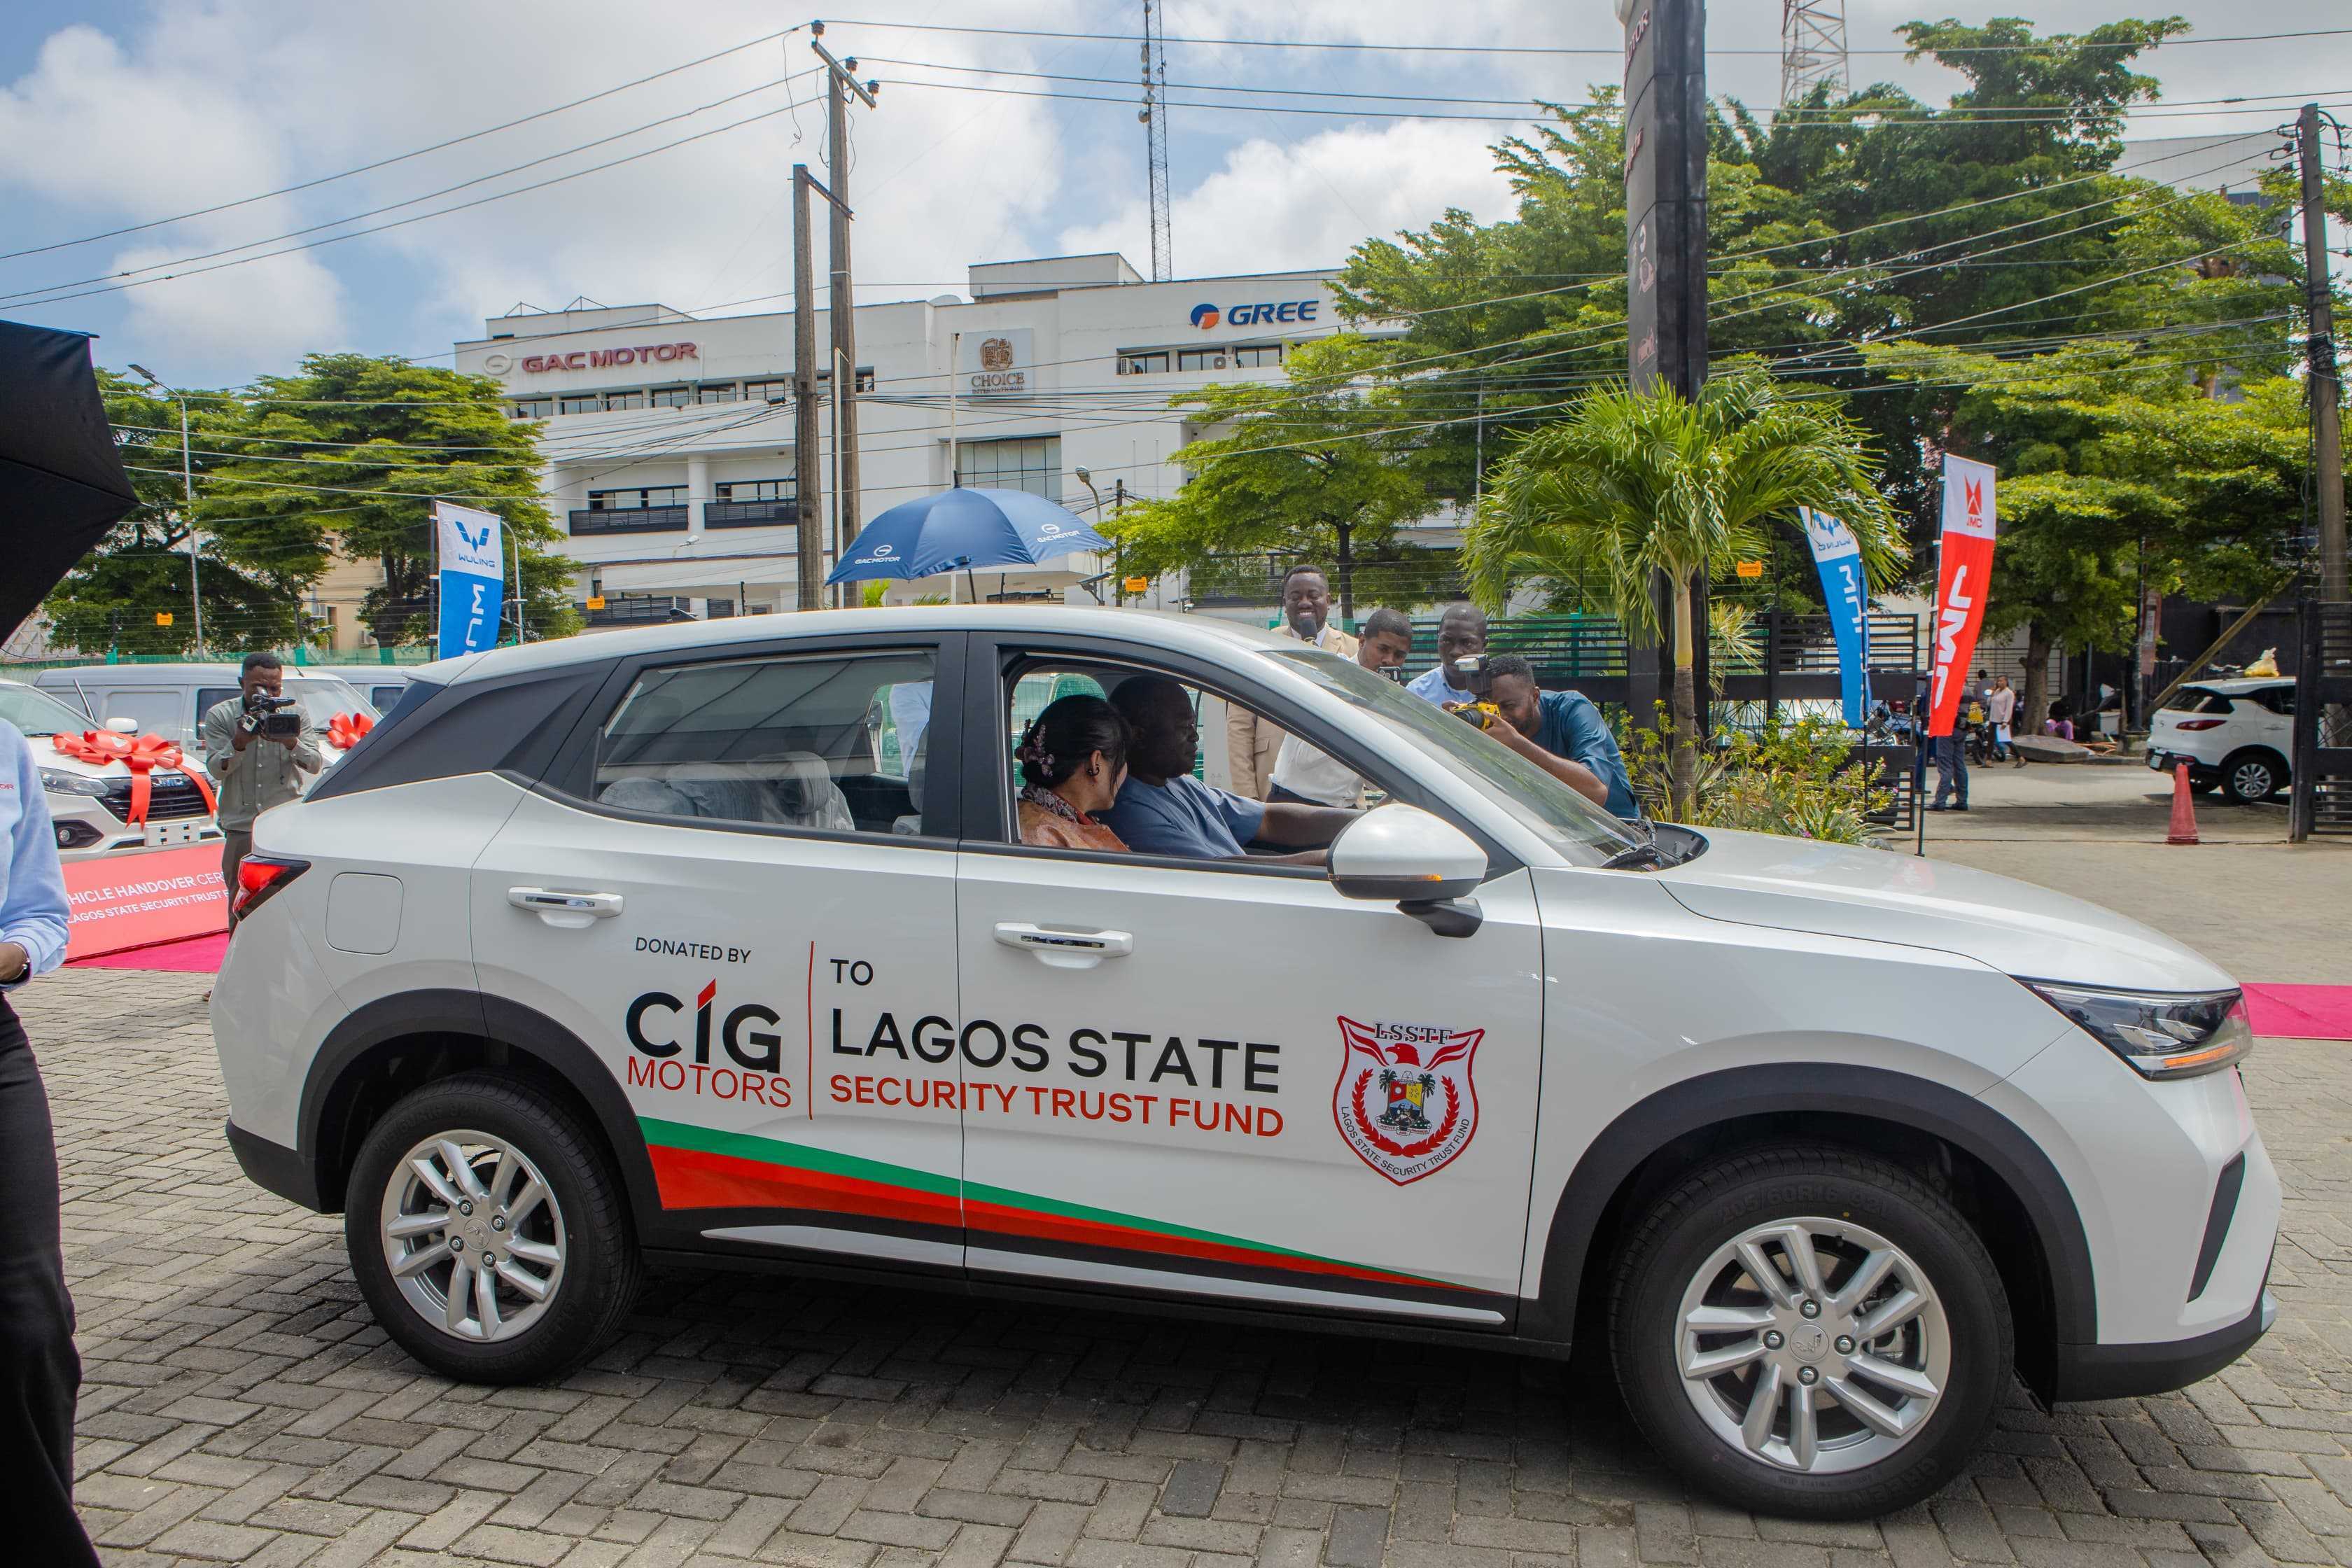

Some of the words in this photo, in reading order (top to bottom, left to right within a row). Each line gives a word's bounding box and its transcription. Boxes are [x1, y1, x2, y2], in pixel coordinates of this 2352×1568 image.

[1228, 300, 1320, 326] GREE
[522, 351, 587, 373] GAC
[590, 342, 699, 368] MOTOR
[971, 372, 1025, 387] CHOICE
[1966, 517, 1982, 528] JMC
[458, 554, 496, 568] WULING
[67, 888, 115, 905] HICLE
[114, 876, 197, 898] HANDOVER
[197, 871, 225, 885] CER
[106, 904, 139, 918] STATE
[140, 896, 192, 911] SECURITY
[190, 890, 222, 902] TRUST
[636, 937, 724, 961] DONATED
[727, 947, 752, 965] BY
[830, 958, 874, 986] TO
[1374, 1023, 1453, 1045] LSSTF
[832, 1008, 1050, 1074] LAGOS
[1068, 1028, 1281, 1094] STATE
[627, 1055, 792, 1109] MOTORS
[830, 1074, 1018, 1114] SECURITY
[1026, 1086, 1159, 1126] TRUST
[1169, 1098, 1284, 1138] FUND
[1340, 1106, 1358, 1139] LAGOS
[1355, 1138, 1382, 1163] STATE
[1380, 1160, 1427, 1176] SECURITY
[1428, 1142, 1456, 1166] TRUST
[1453, 1118, 1469, 1148] FUND
